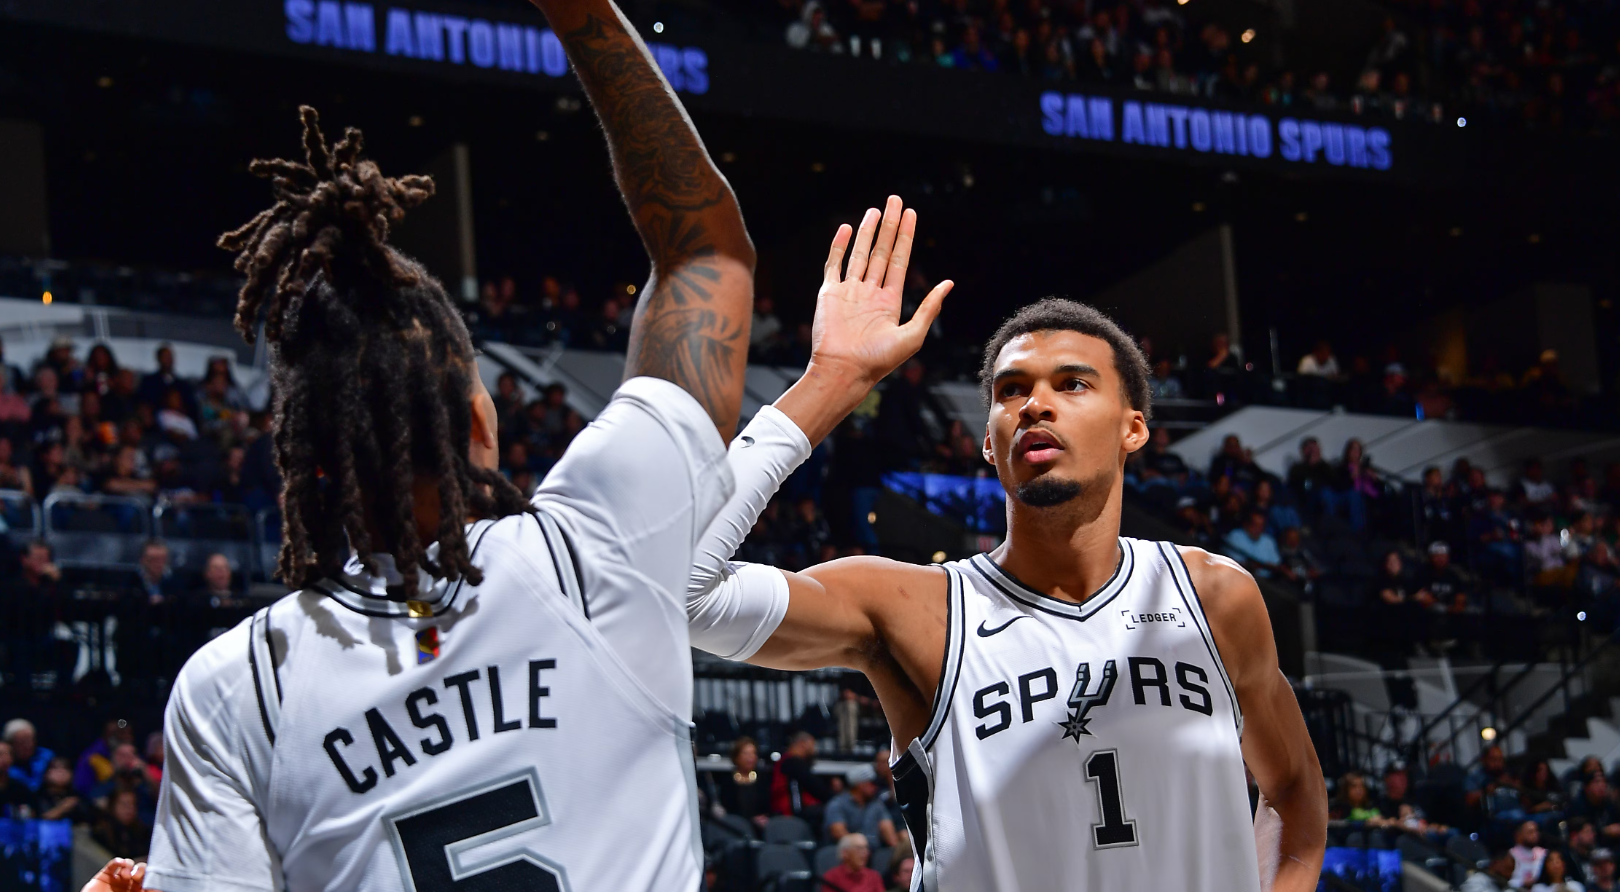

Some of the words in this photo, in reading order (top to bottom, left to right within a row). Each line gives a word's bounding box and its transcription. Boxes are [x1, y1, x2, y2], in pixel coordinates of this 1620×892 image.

[284, 0, 376, 52] SAN
[385, 8, 568, 77] ANTONIO
[1040, 92, 1114, 141] SAN
[1122, 101, 1273, 158] ANTONIO
[1278, 118, 1393, 170] SPURS
[1131, 612, 1177, 623] LEDGER
[323, 658, 557, 794] CASTLE
[972, 656, 1213, 744] SPURS
[382, 765, 573, 892] 5
[1082, 747, 1139, 851] 1
